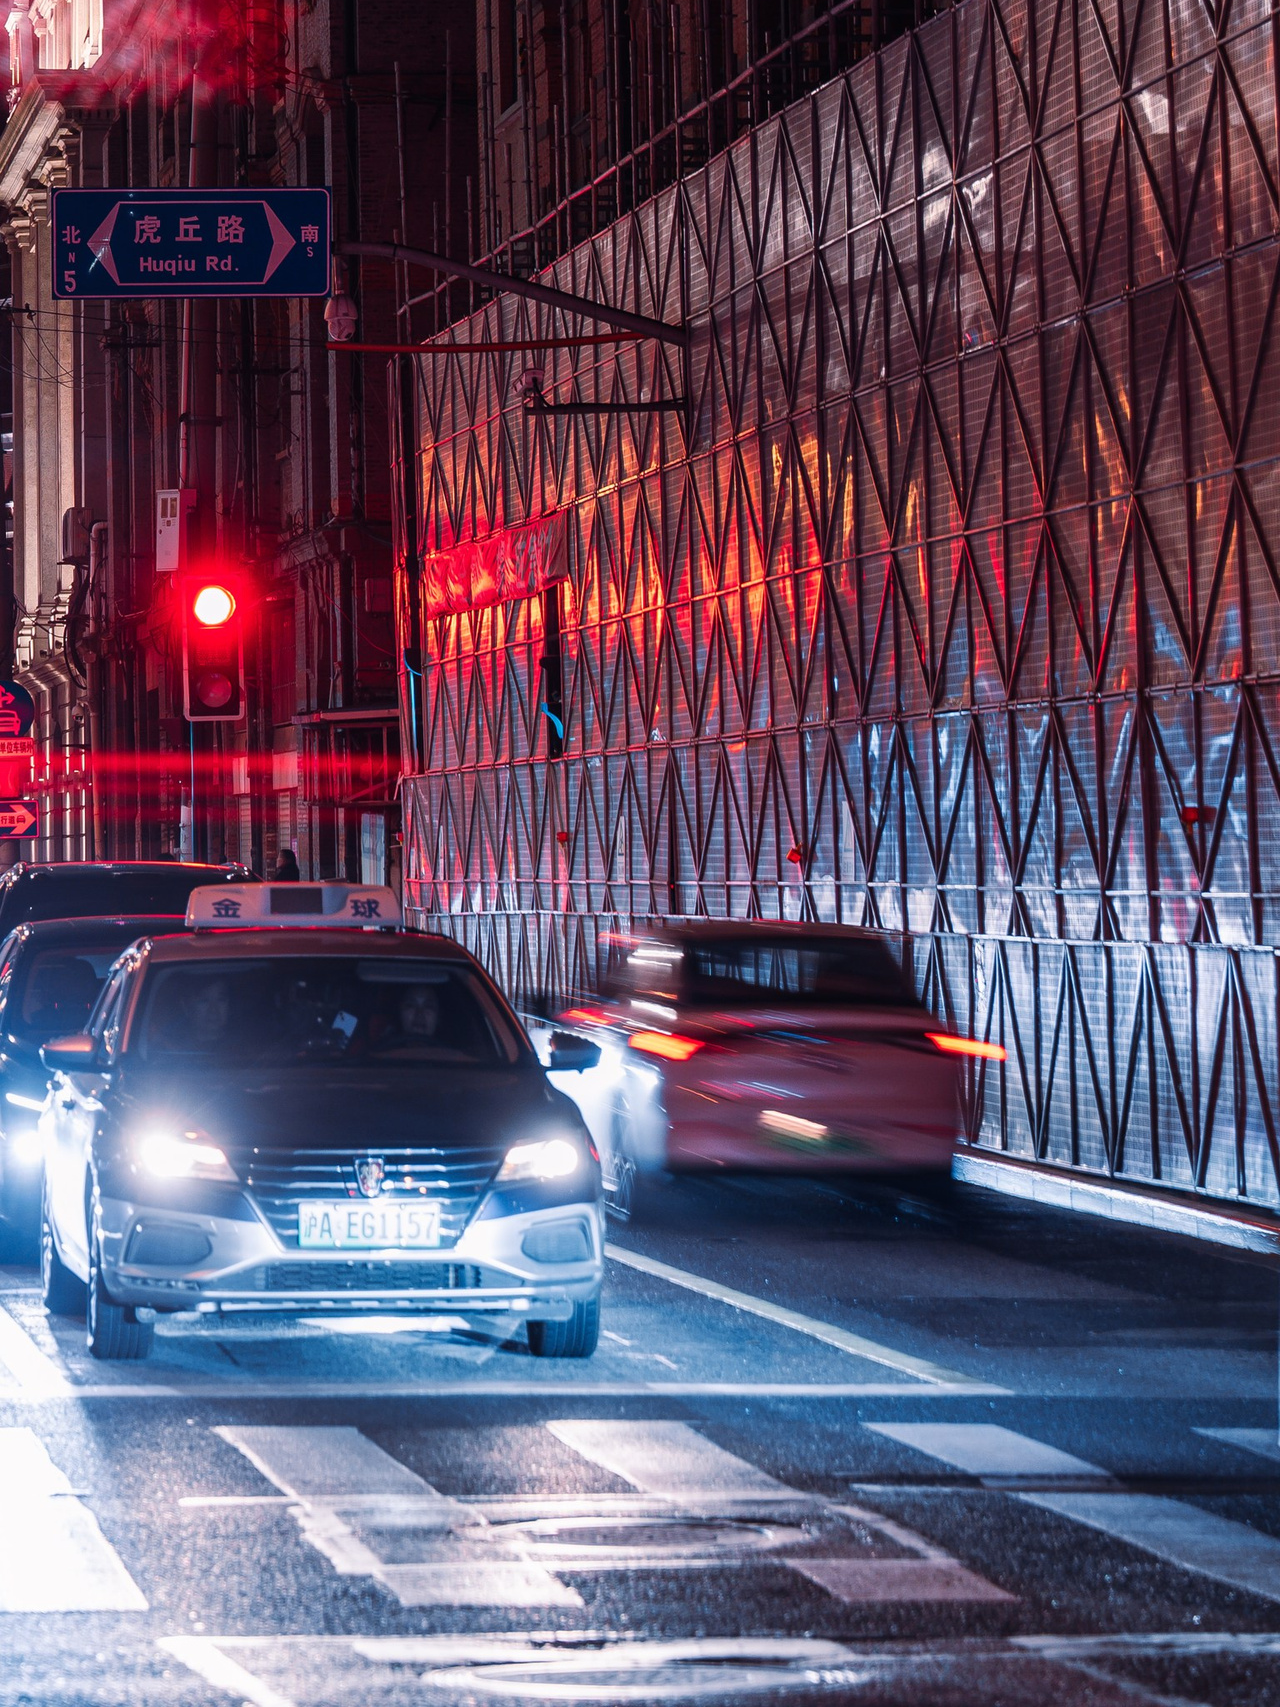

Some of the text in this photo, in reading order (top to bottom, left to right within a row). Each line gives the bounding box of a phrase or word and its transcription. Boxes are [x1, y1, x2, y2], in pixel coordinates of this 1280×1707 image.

[62, 225, 81, 244] 北
[133, 215, 246, 244] 虎丘路
[300, 224, 319, 243] 南
[68, 252, 76, 264] N
[306, 246, 314, 257] S
[139, 255, 239, 276] Huqiu Rd.
[64, 270, 77, 292] 5
[211, 898, 381, 919] 金 球
